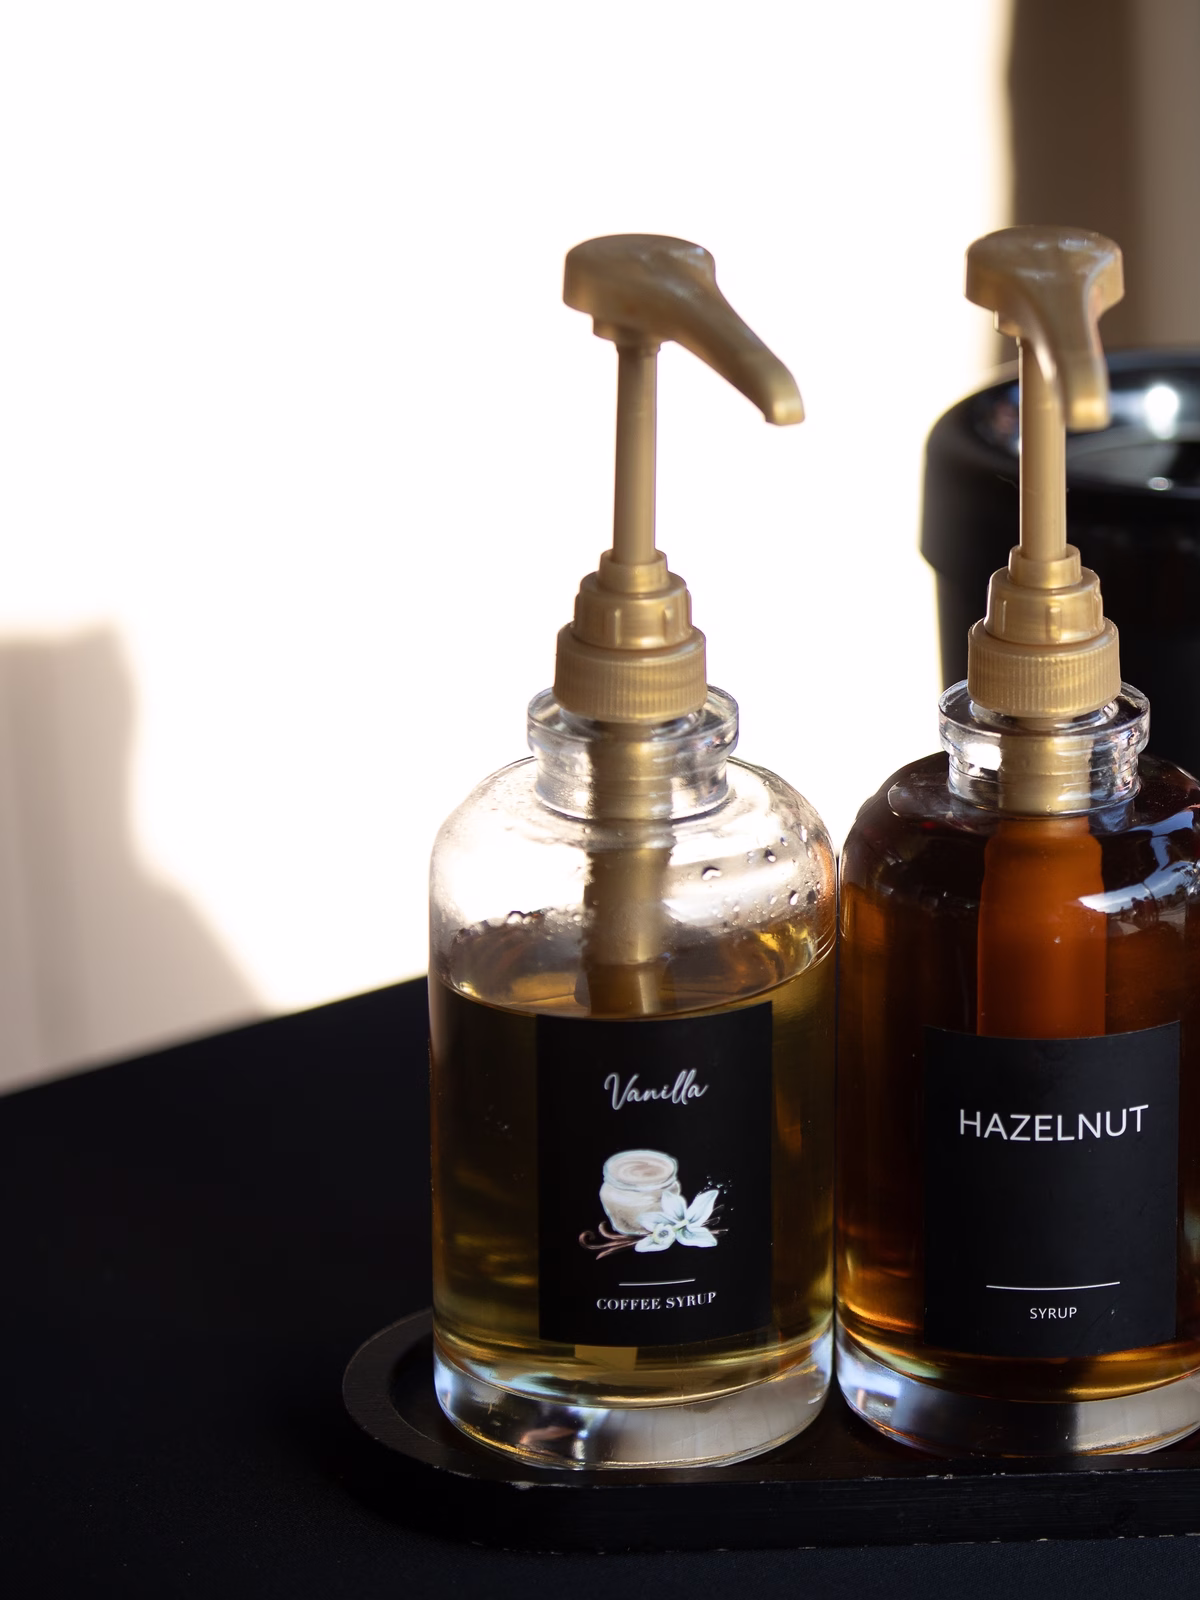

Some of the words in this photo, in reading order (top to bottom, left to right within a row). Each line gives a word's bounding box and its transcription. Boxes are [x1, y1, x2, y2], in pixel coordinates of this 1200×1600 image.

[603, 1068, 708, 1111] Vanilla
[960, 1103, 1149, 1142] HAZELNUT
[596, 1298, 661, 1311] COFFEE
[665, 1291, 717, 1309] SYRUP
[1029, 1306, 1078, 1320] SYRUP
